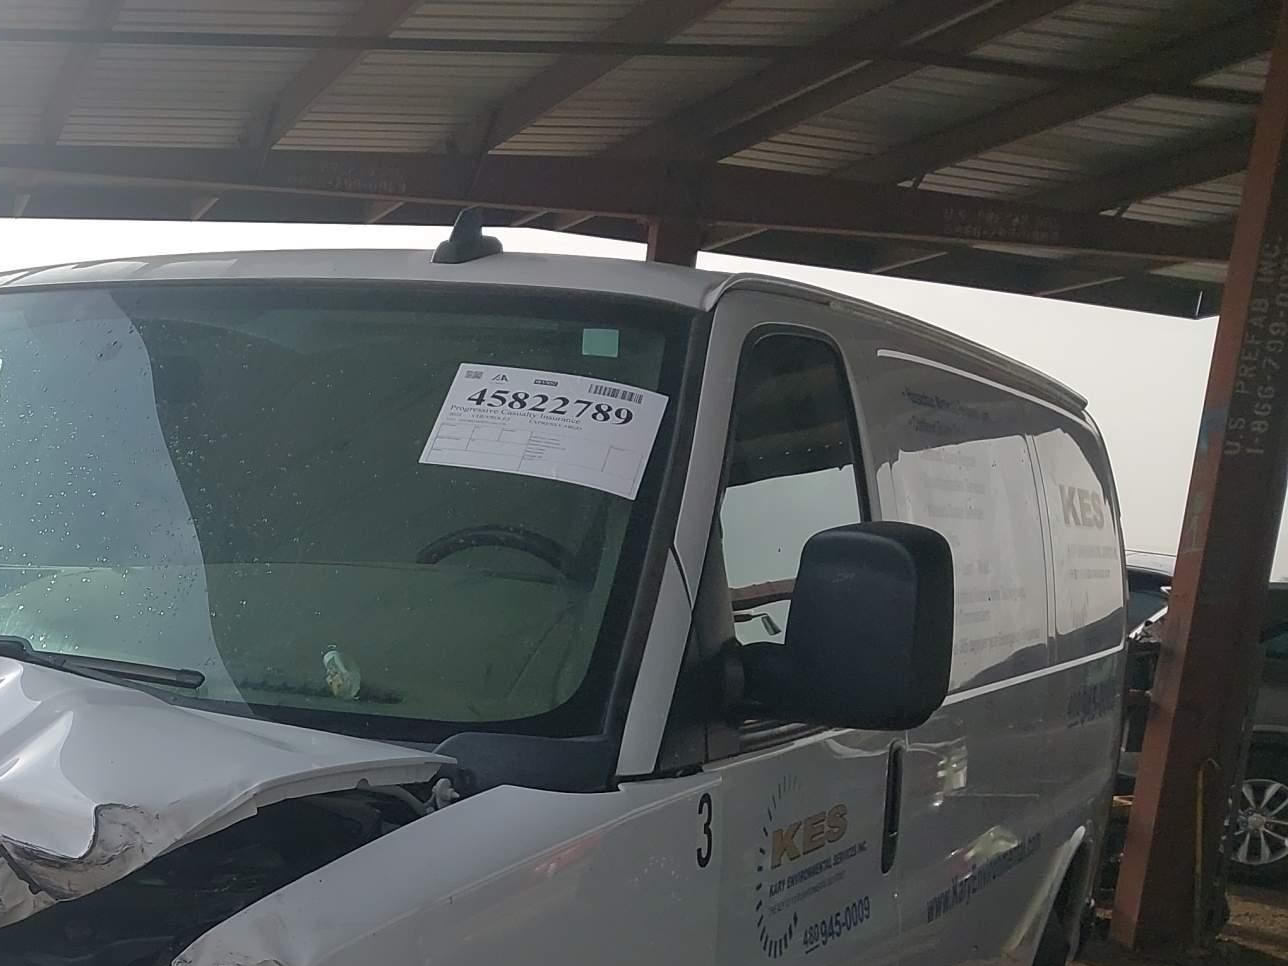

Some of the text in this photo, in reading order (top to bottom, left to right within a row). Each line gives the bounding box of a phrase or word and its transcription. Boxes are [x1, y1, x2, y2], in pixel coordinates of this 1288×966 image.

[1234, 296, 1271, 395] PREFAB
[450, 404, 582, 425] Progressive Casualty Insurance
[466, 387, 634, 426] 45822789
[1058, 484, 1106, 530] KES
[695, 793, 713, 869] 3
[771, 803, 848, 870] KES
[820, 896, 871, 946] 945-0009
